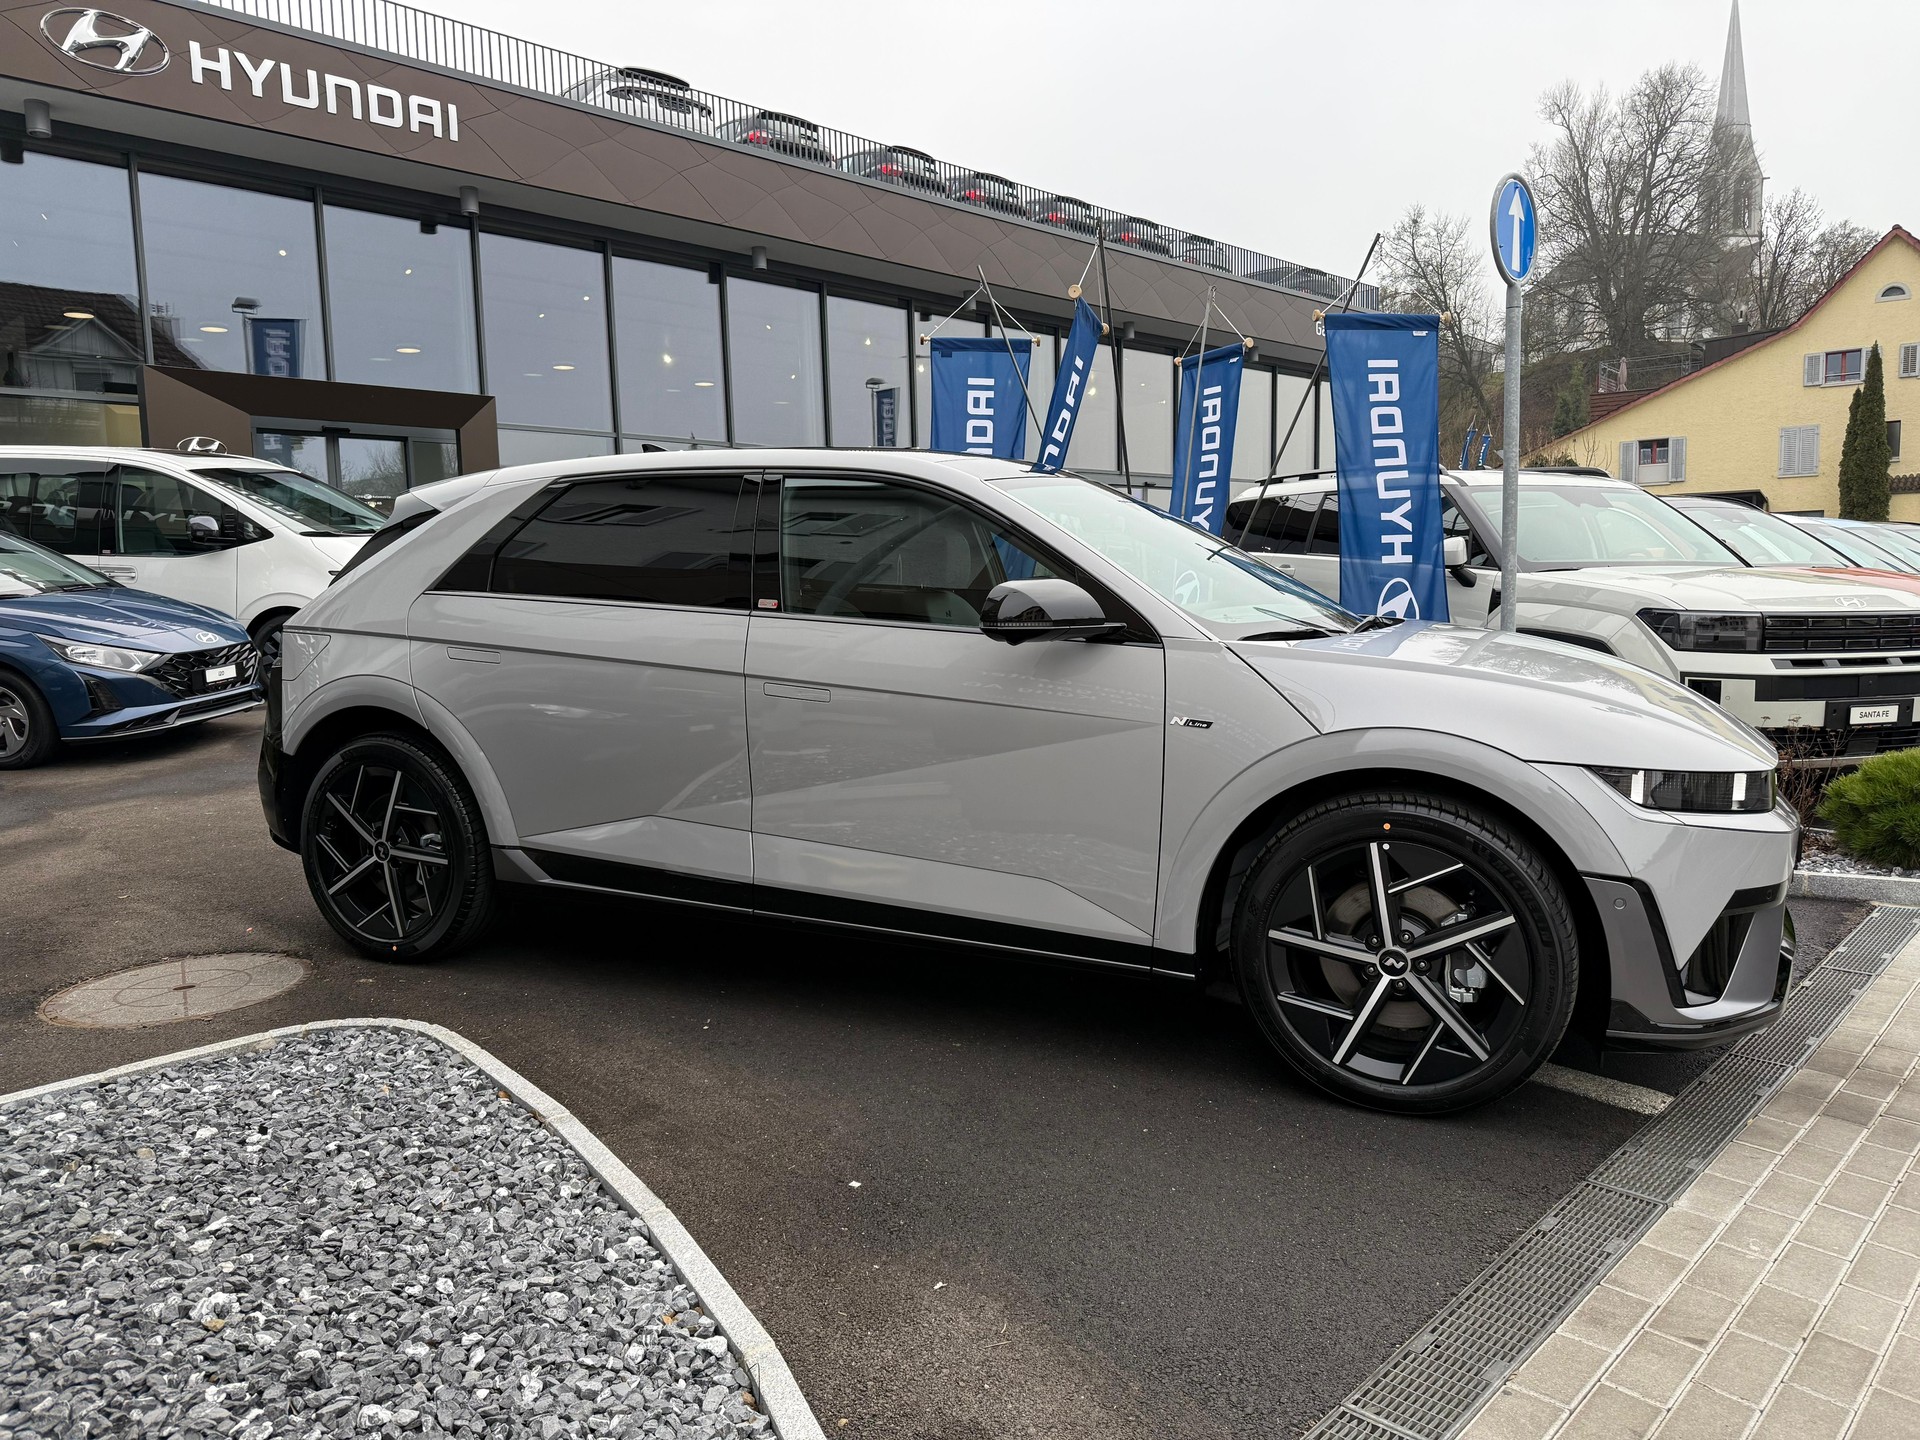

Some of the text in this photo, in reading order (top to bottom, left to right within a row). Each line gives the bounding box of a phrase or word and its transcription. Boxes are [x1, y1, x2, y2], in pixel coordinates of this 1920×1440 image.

[188, 40, 459, 142] HYUNDAI
[1859, 710, 1890, 719] SANTA FE
[1170, 716, 1188, 726] N
